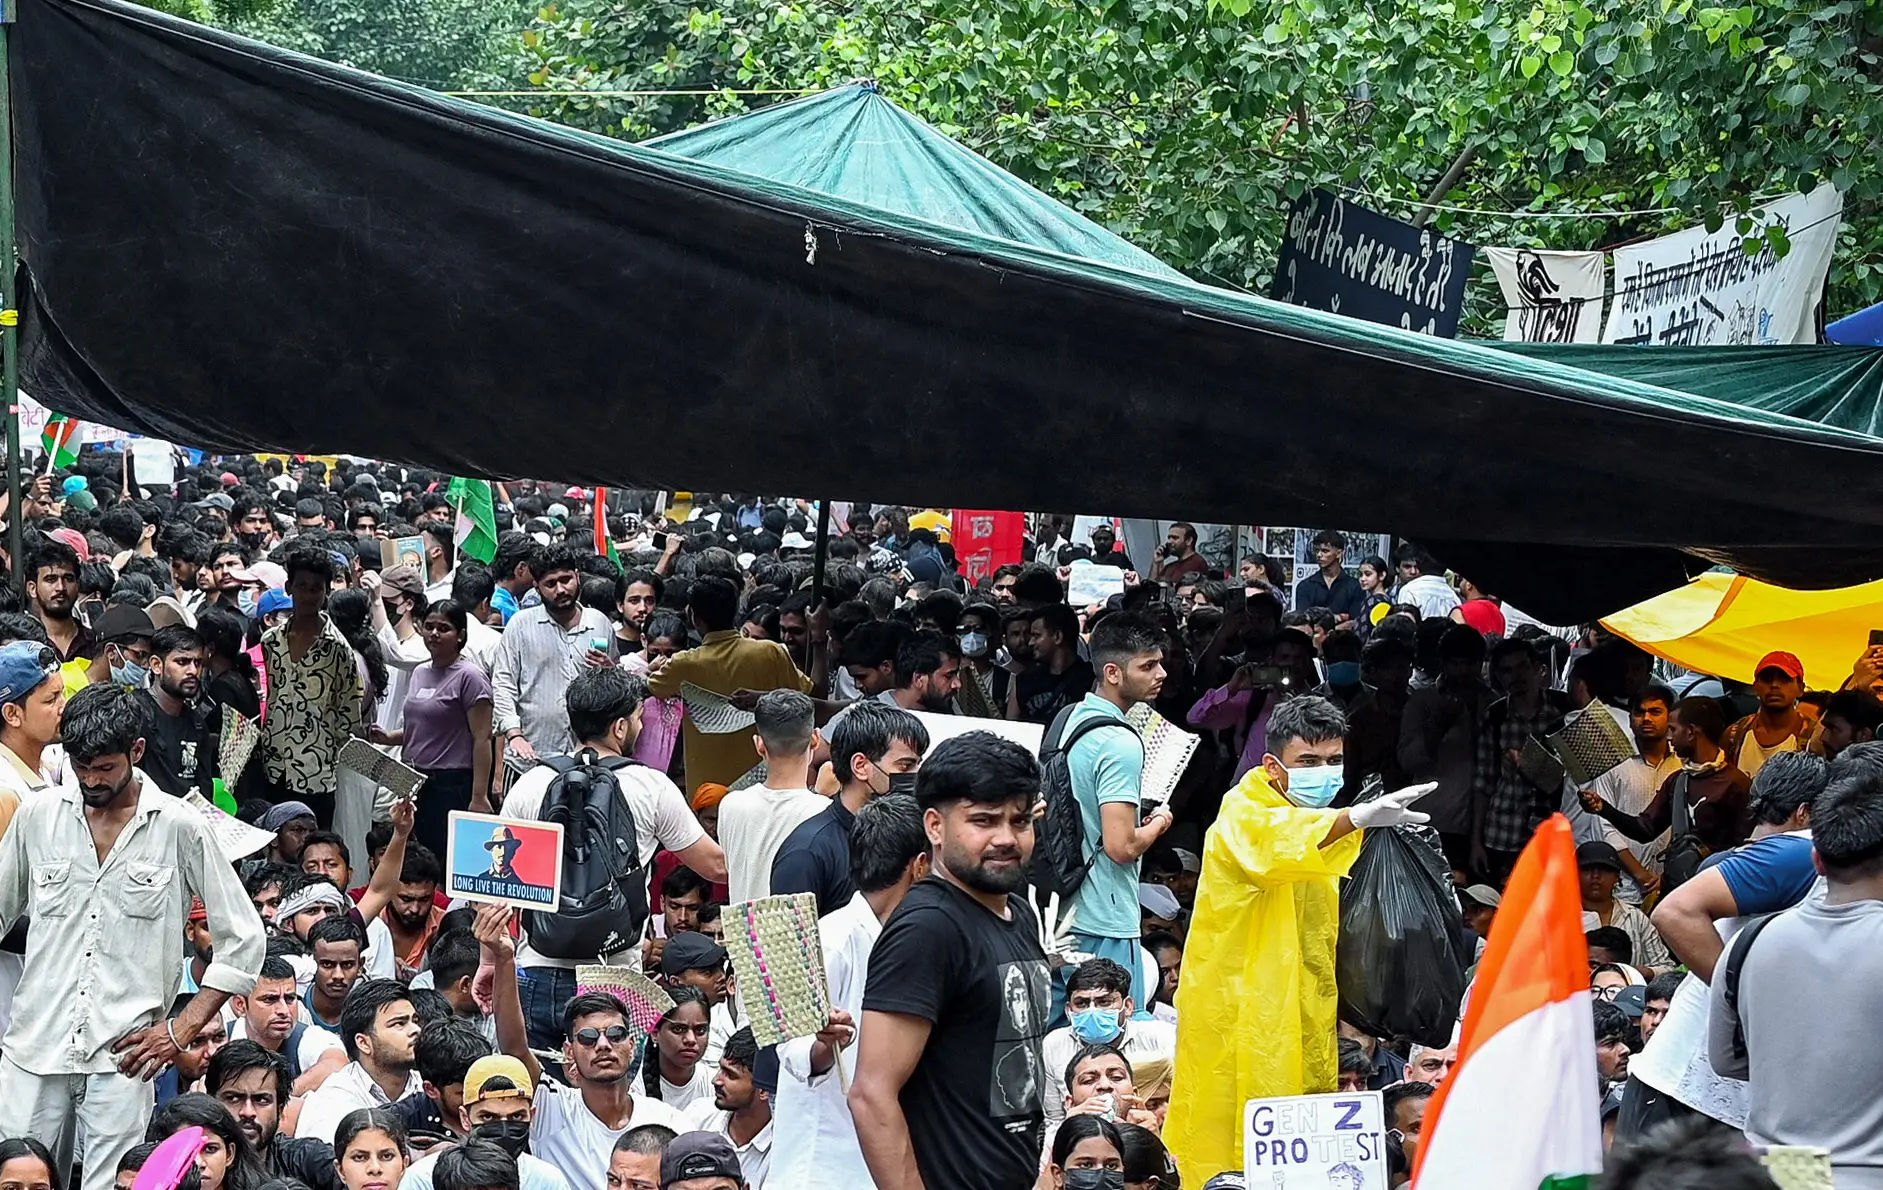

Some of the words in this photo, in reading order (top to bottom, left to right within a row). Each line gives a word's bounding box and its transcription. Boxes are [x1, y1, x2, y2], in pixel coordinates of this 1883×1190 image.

[453, 875, 474, 891] LONG
[475, 878, 491, 894] LIVE
[491, 881, 506, 896] THE
[507, 884, 553, 902] REVOLUTION
[1252, 1102, 1318, 1137] GEN
[1333, 1101, 1364, 1131] Z
[1255, 1132, 1380, 1166] PROTEST
